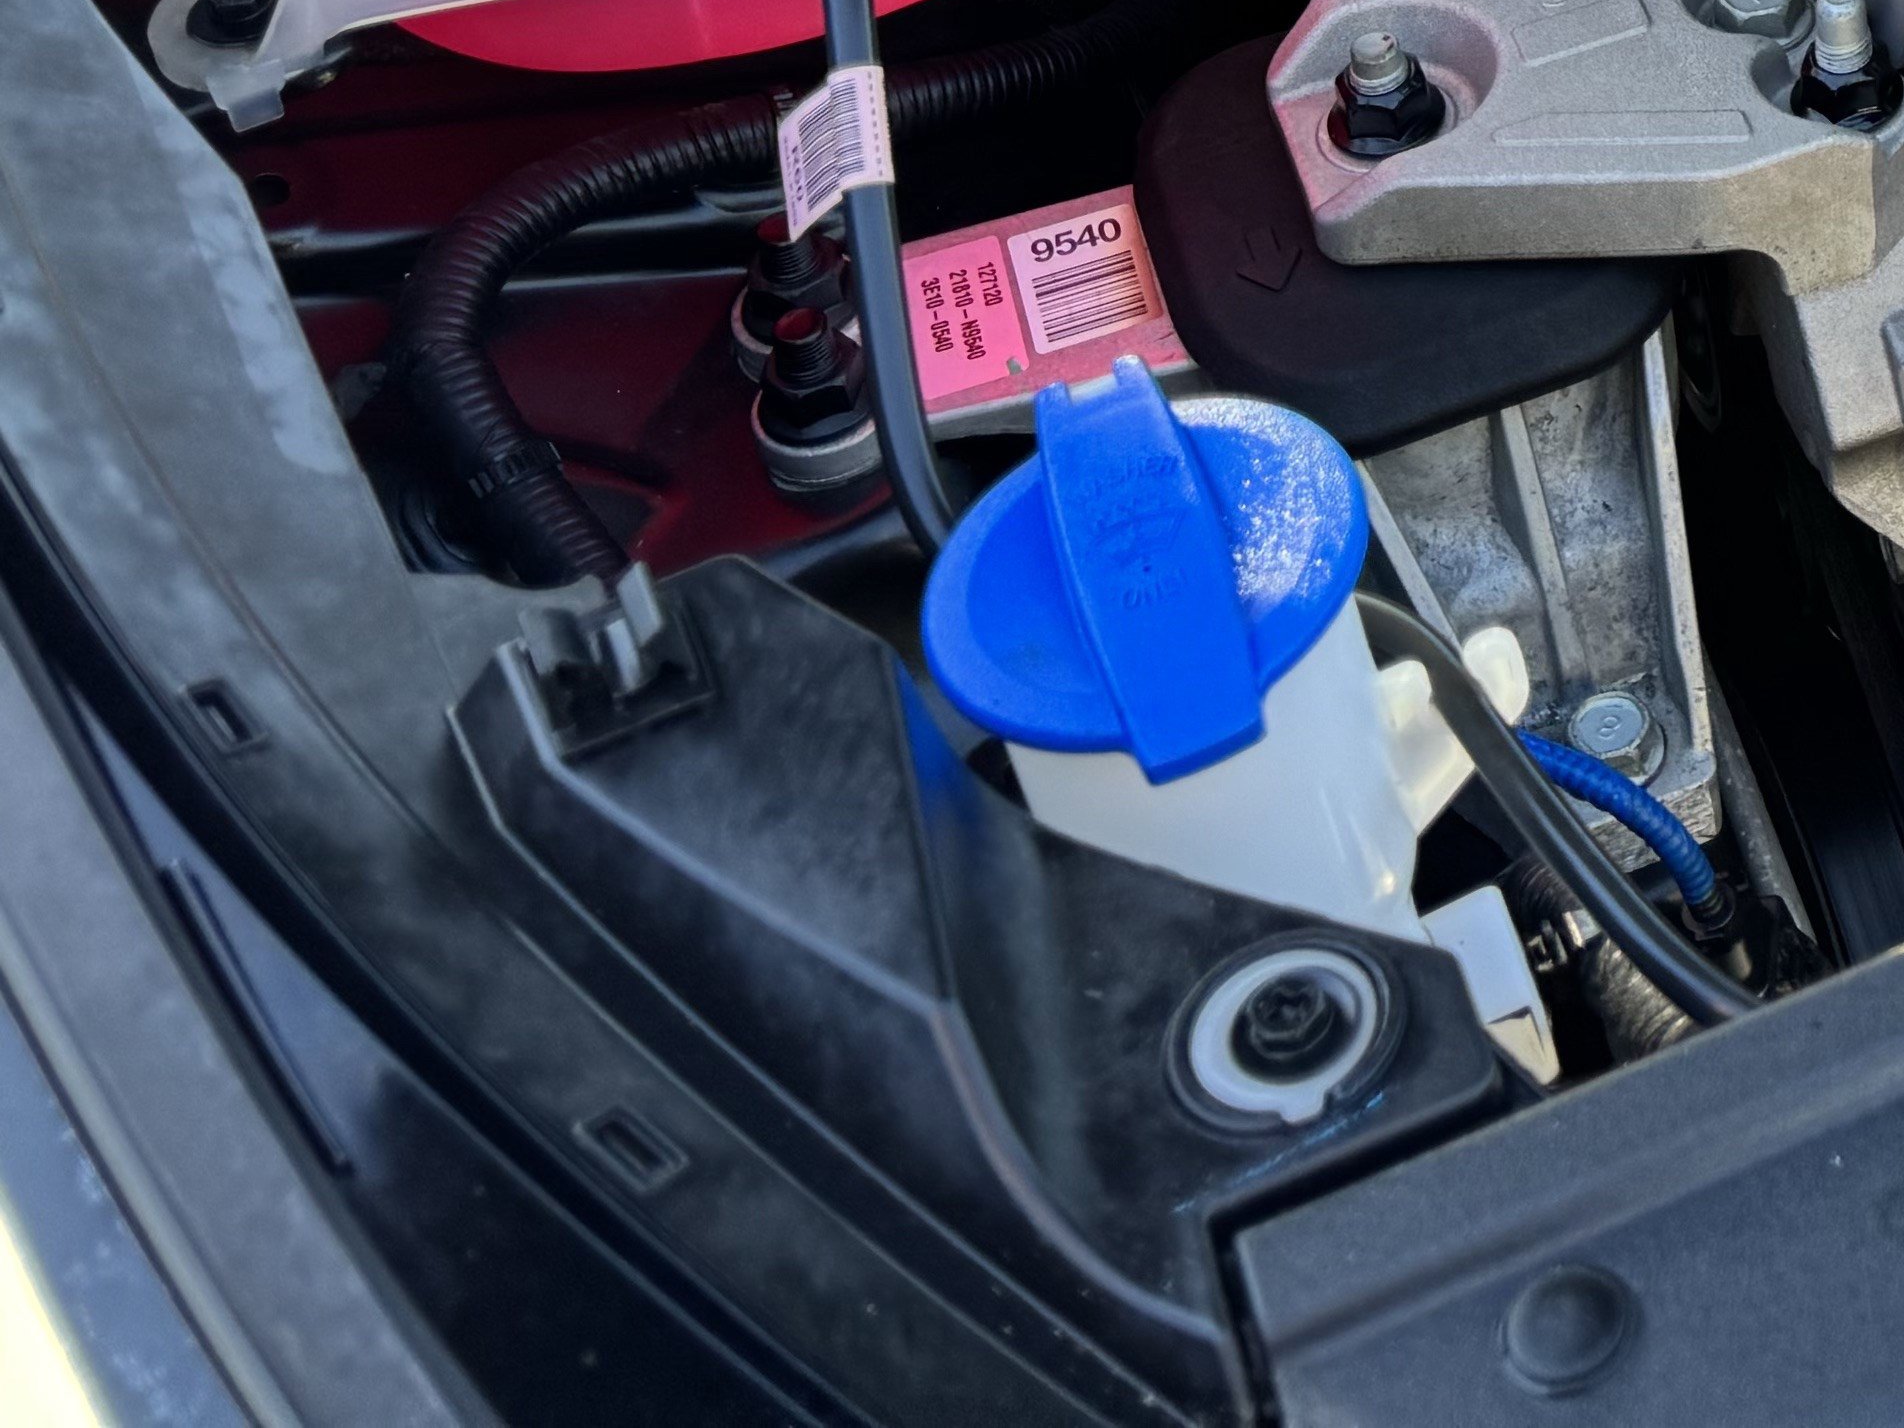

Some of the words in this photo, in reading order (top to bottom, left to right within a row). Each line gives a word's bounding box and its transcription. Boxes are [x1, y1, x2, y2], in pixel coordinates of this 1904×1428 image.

[1030, 217, 1122, 264] 9540
[978, 261, 1004, 307] 127120
[948, 269, 985, 360] 21810-N9540
